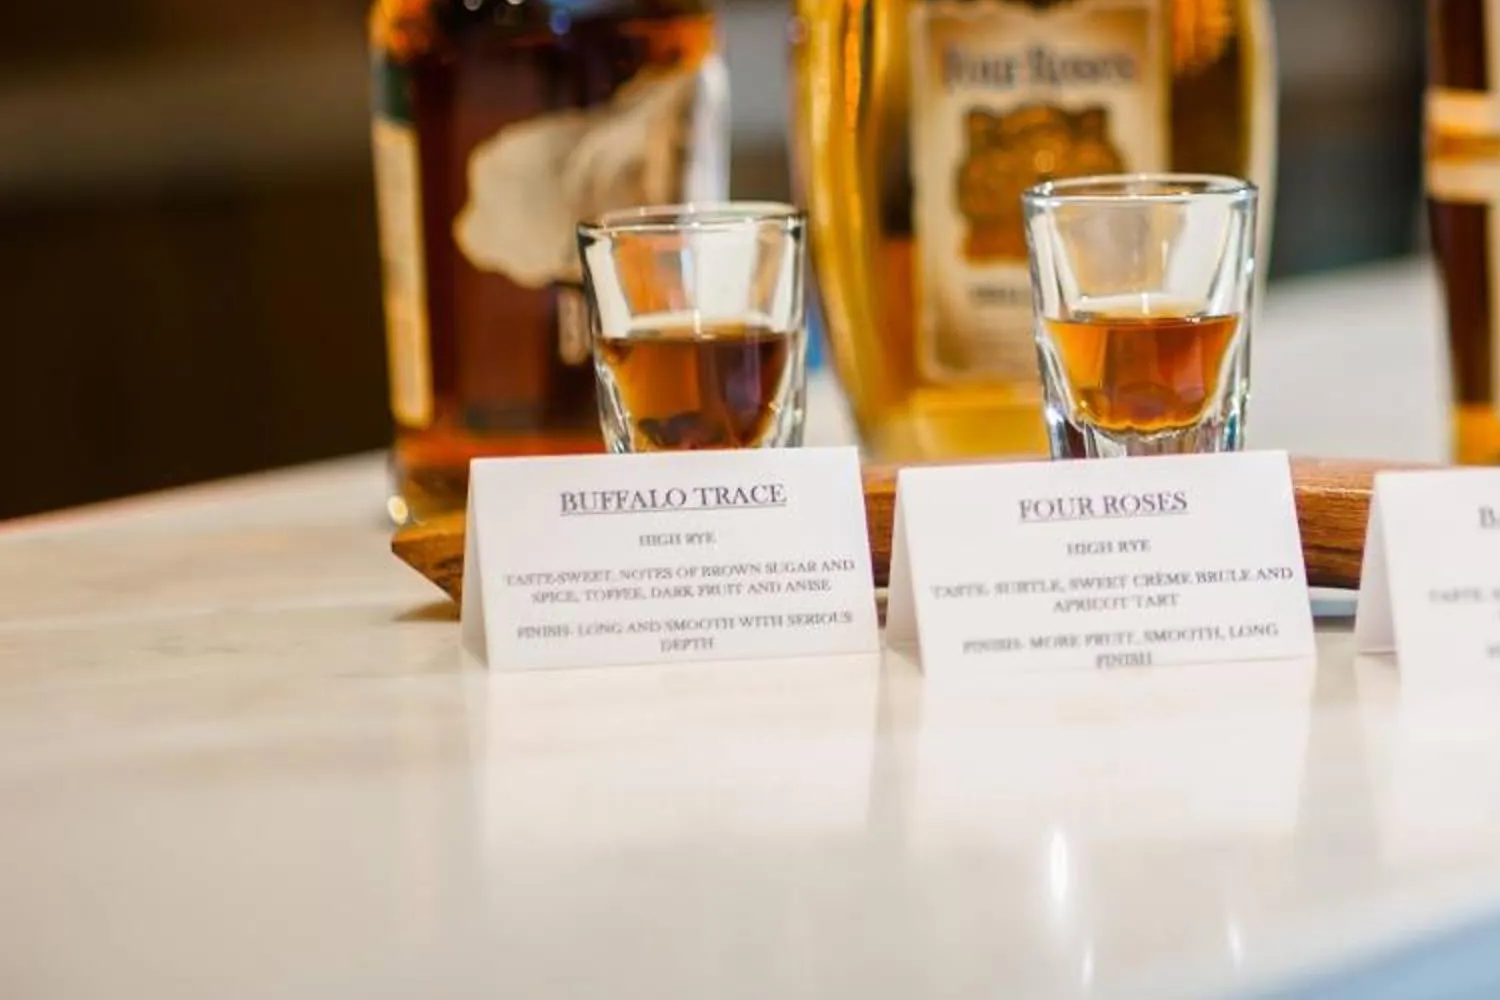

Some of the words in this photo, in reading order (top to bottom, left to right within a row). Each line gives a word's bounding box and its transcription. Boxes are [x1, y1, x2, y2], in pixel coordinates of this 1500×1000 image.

[560, 488, 687, 513] BUFFALO
[693, 483, 787, 507] TRACE
[1019, 497, 1095, 523] FOUR
[1102, 491, 1188, 517] ROSES
[639, 533, 682, 546] HIGH
[686, 532, 716, 545] RYE
[1066, 541, 1113, 555] HIGH
[1118, 539, 1151, 553] RYE
[620, 567, 673, 581] NOTES
[676, 566, 699, 579] OF
[702, 563, 761, 578] BROWN
[765, 560, 817, 576] SUGAR
[820, 559, 855, 572] AND
[1068, 575, 1129, 591] SWEET
[1256, 566, 1294, 581] AND
[650, 584, 694, 599] DARK
[697, 582, 745, 597] FRUIT
[748, 580, 782, 595] AND
[785, 578, 832, 593] ANISE
[1052, 597, 1128, 614] APRICOT
[1132, 594, 1181, 610] TART
[578, 621, 623, 637] LONG
[626, 619, 662, 633] AND
[665, 615, 735, 632] SMOOTH
[738, 613, 784, 628] WITH
[787, 611, 853, 627] SERIOUS
[660, 636, 715, 653] DEPTH
[1029, 633, 1080, 651] MORE
[1229, 623, 1279, 638] LONG
